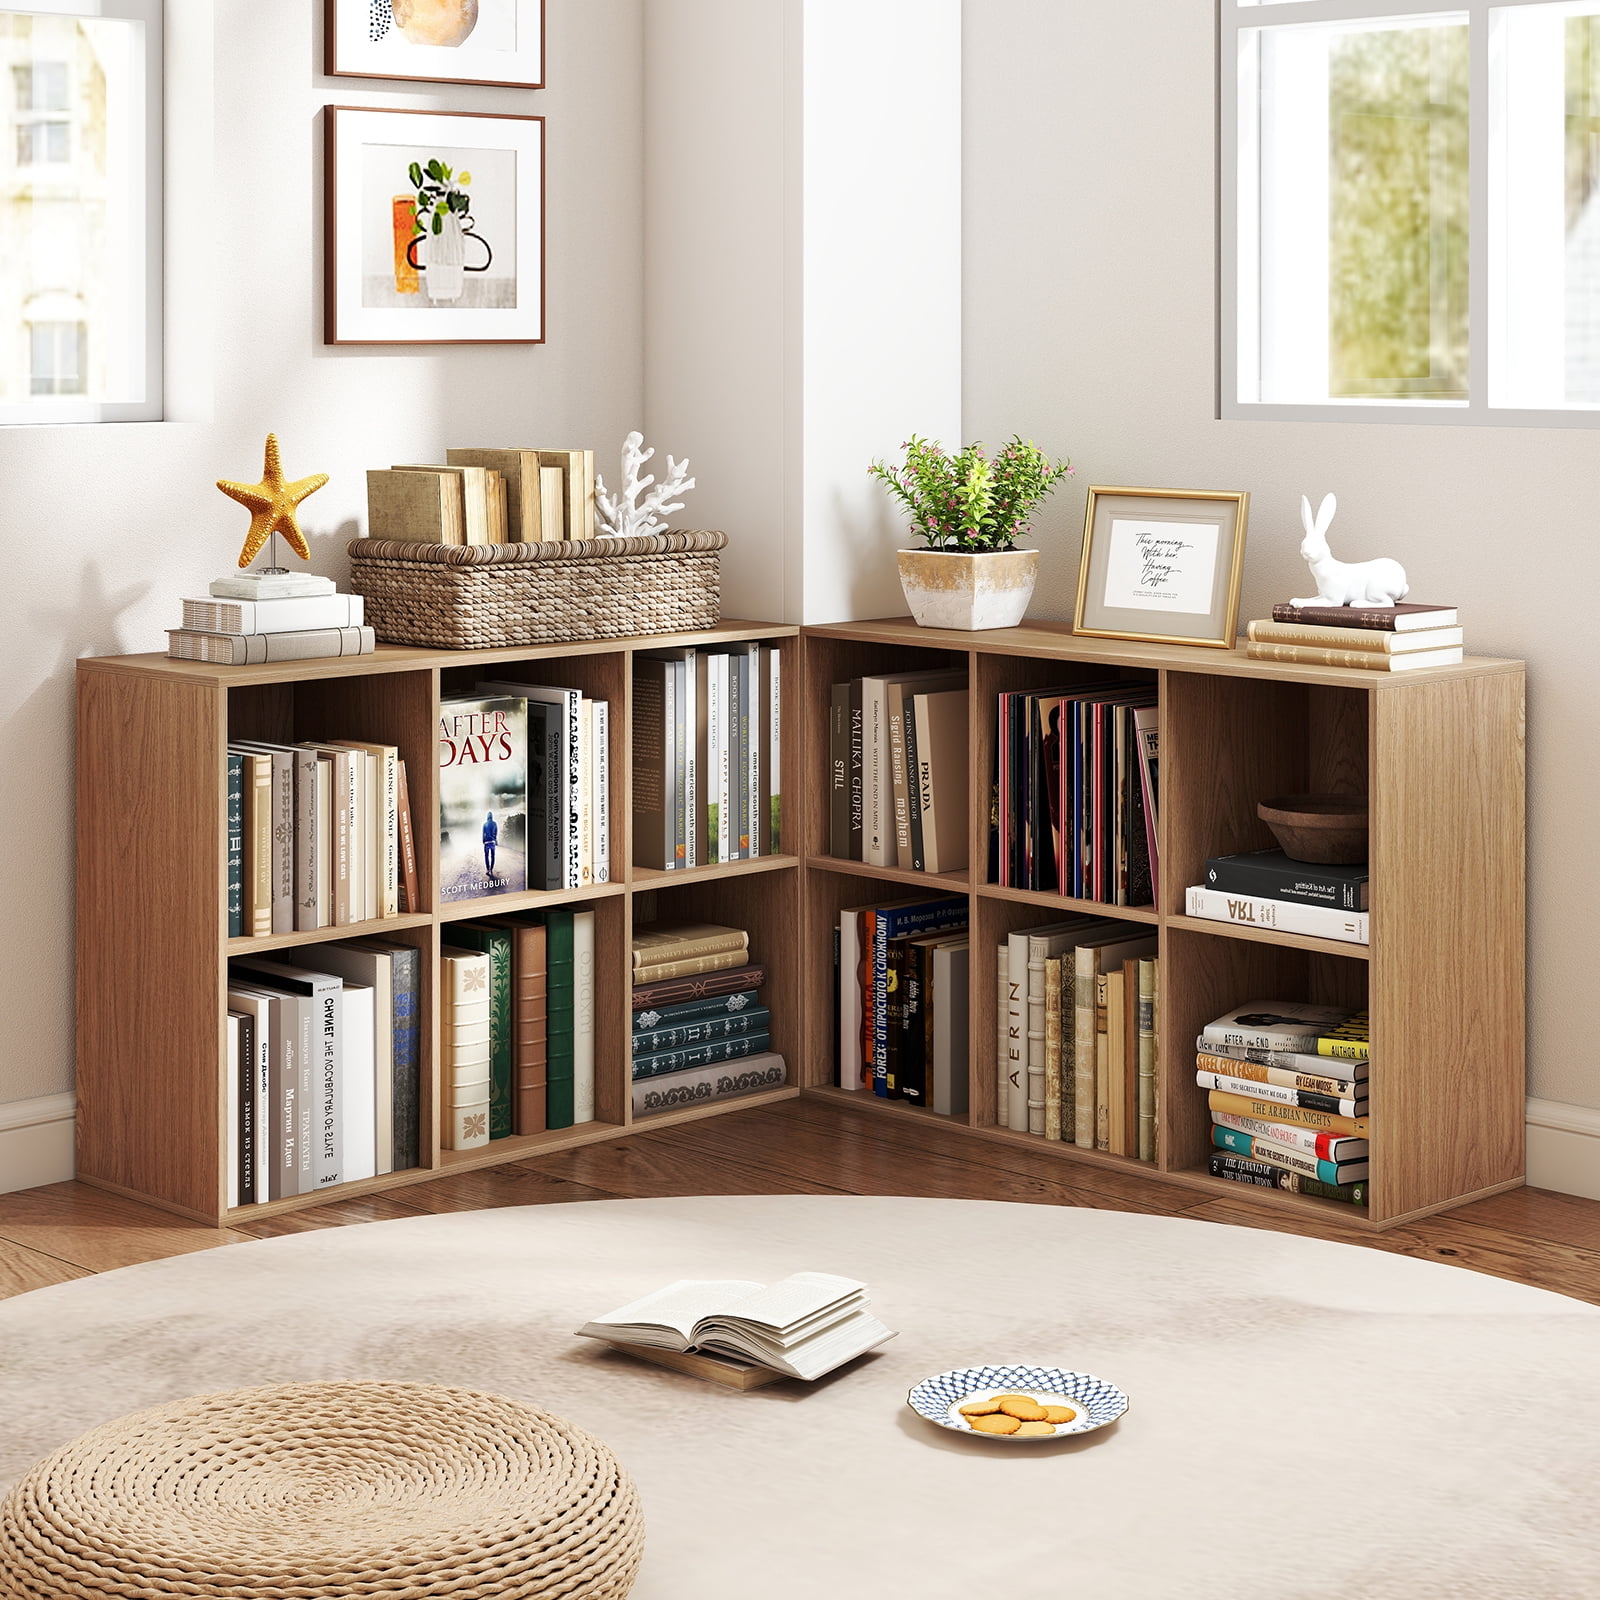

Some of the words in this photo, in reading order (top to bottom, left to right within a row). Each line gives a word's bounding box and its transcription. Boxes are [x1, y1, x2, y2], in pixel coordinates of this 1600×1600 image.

[1135, 533, 1153, 546] This
[1141, 544, 1163, 560] With
[1142, 558, 1182, 576] Having
[667, 710, 673, 720] OF
[711, 710, 717, 721] OF
[732, 702, 738, 713] OF
[440, 711, 510, 738] AFTER
[890, 715, 902, 744] Sigrid
[905, 710, 913, 735] JOHN
[440, 731, 513, 768] DAYS
[852, 709, 861, 769] MALLIKA
[893, 747, 903, 785] Rausing
[906, 736, 916, 784] GALLIANO
[834, 759, 844, 790] STILL
[921, 762, 931, 812] PRADA
[852, 776, 861, 831] CHOPRA
[873, 800, 879, 809] IN
[340, 825, 346, 835] DO
[403, 825, 409, 834] DO
[896, 798, 909, 847] mayhem
[340, 836, 346, 846] WE
[404, 834, 410, 844] WE
[441, 886, 467, 896] SCOTT
[470, 877, 511, 891] MEDBURY
[876, 914, 887, 970] СЛОЖНОМУ
[876, 971, 887, 980] К
[580, 951, 592, 1035] LUXDECO
[876, 980, 887, 1028] ПРОСТОГО
[876, 1029, 887, 1041] ОТ
[1009, 982, 1020, 1089] AERIN
[1224, 1033, 1244, 1046] AFTER
[1256, 1037, 1269, 1048] END
[876, 1043, 887, 1080] FOREX:
[1331, 1045, 1356, 1058] AUTHOR
[1259, 1086, 1269, 1095] WANT
[1276, 1090, 1288, 1100] DEAD
[1296, 1075, 1303, 1087] BY
[1303, 1076, 1316, 1089] LEAH
[1315, 1078, 1333, 1093] MOOSE
[244, 1100, 252, 1133] замок
[284, 1088, 295, 1133] Мартин
[1251, 1102, 1266, 1115] THE
[1268, 1105, 1302, 1120] ARABIAN
[1302, 1111, 1332, 1127] NIGHTS
[244, 1137, 252, 1149] из
[302, 1107, 310, 1171] ТРАКТАТЫ
[285, 1137, 295, 1167] Иден
[244, 1152, 252, 1188] стекла
